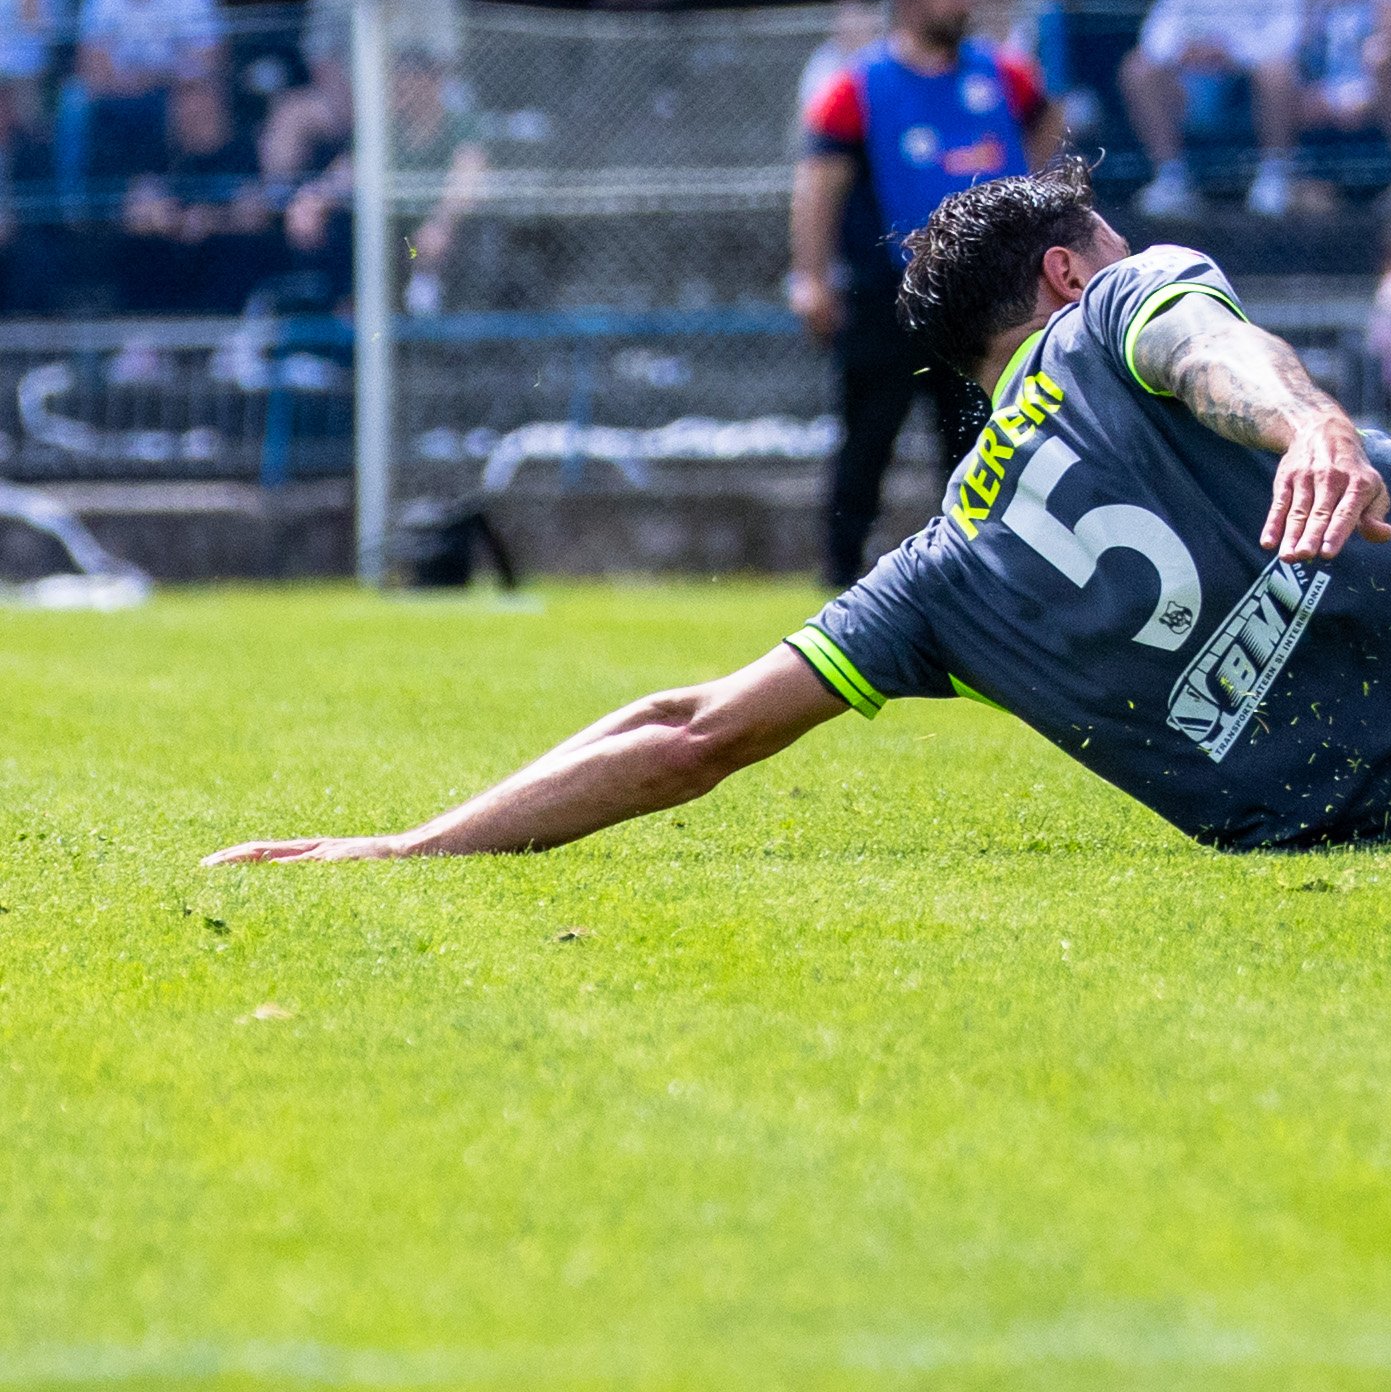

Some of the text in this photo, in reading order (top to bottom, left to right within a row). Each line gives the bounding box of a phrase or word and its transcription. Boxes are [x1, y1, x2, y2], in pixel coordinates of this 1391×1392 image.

[950, 370, 1065, 542] KEREKI
[1001, 434, 1202, 652] 5
[1214, 704, 1253, 757] TRANSPORT
